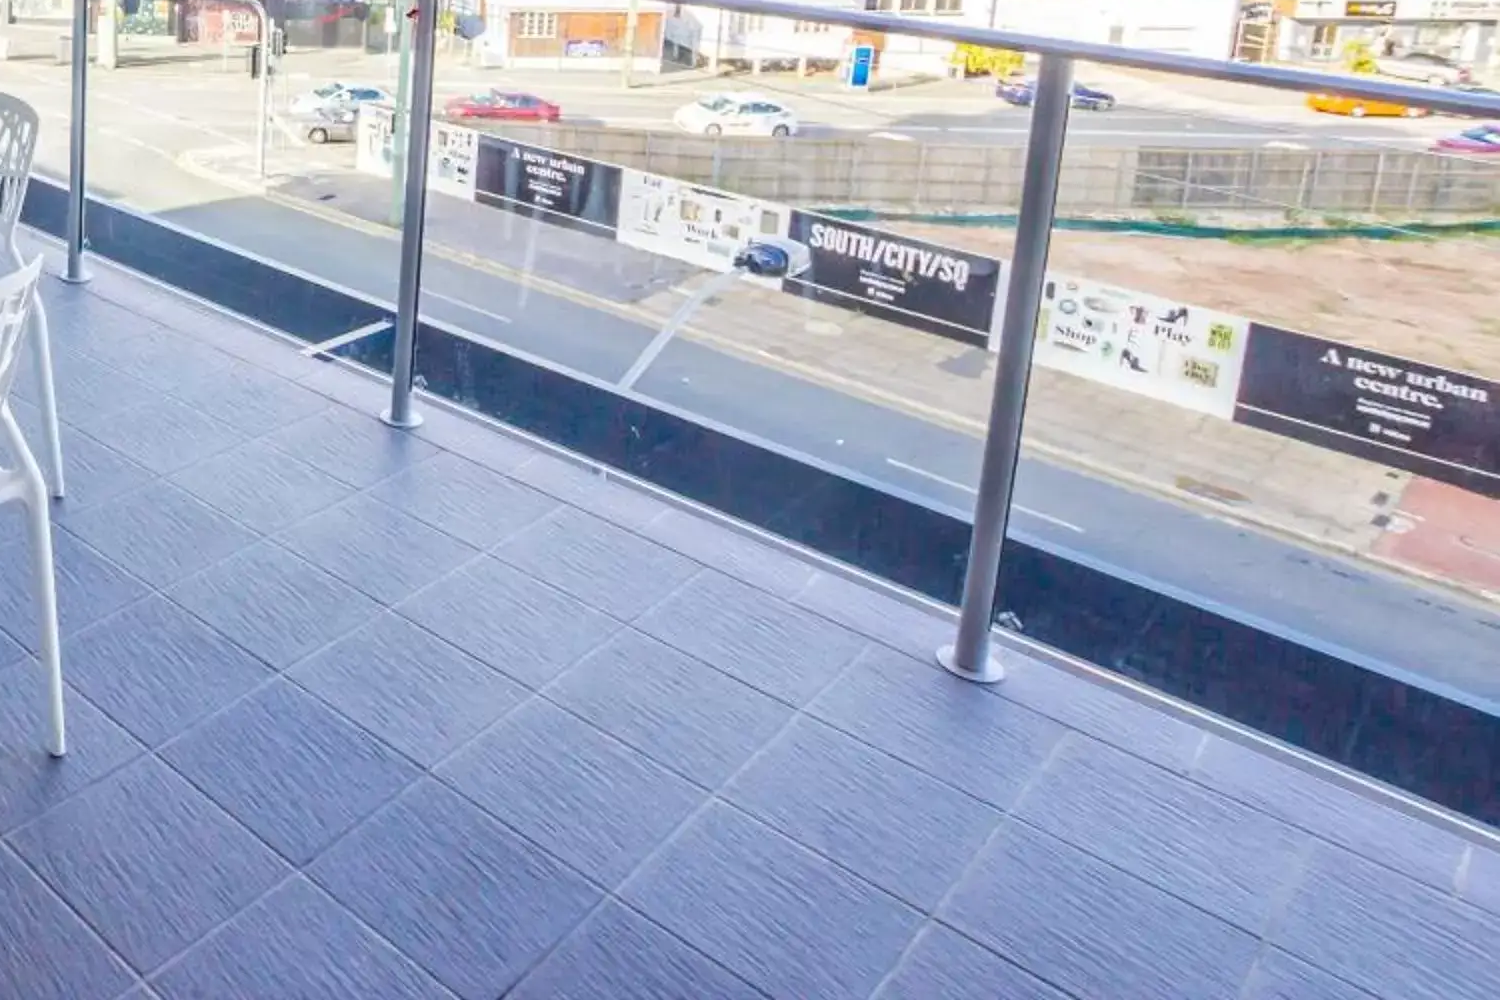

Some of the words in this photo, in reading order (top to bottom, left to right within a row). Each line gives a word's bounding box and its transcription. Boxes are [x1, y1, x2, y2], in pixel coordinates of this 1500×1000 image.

[510, 147, 520, 159] A
[522, 151, 546, 165] new
[549, 156, 585, 176] urban
[809, 223, 970, 291] SOUTH/CITY/SQ
[1055, 323, 1098, 346] Shop
[1319, 348, 1342, 367] A
[1346, 356, 1404, 380] new
[1405, 369, 1489, 403] urban
[1353, 376, 1445, 410] centre.
